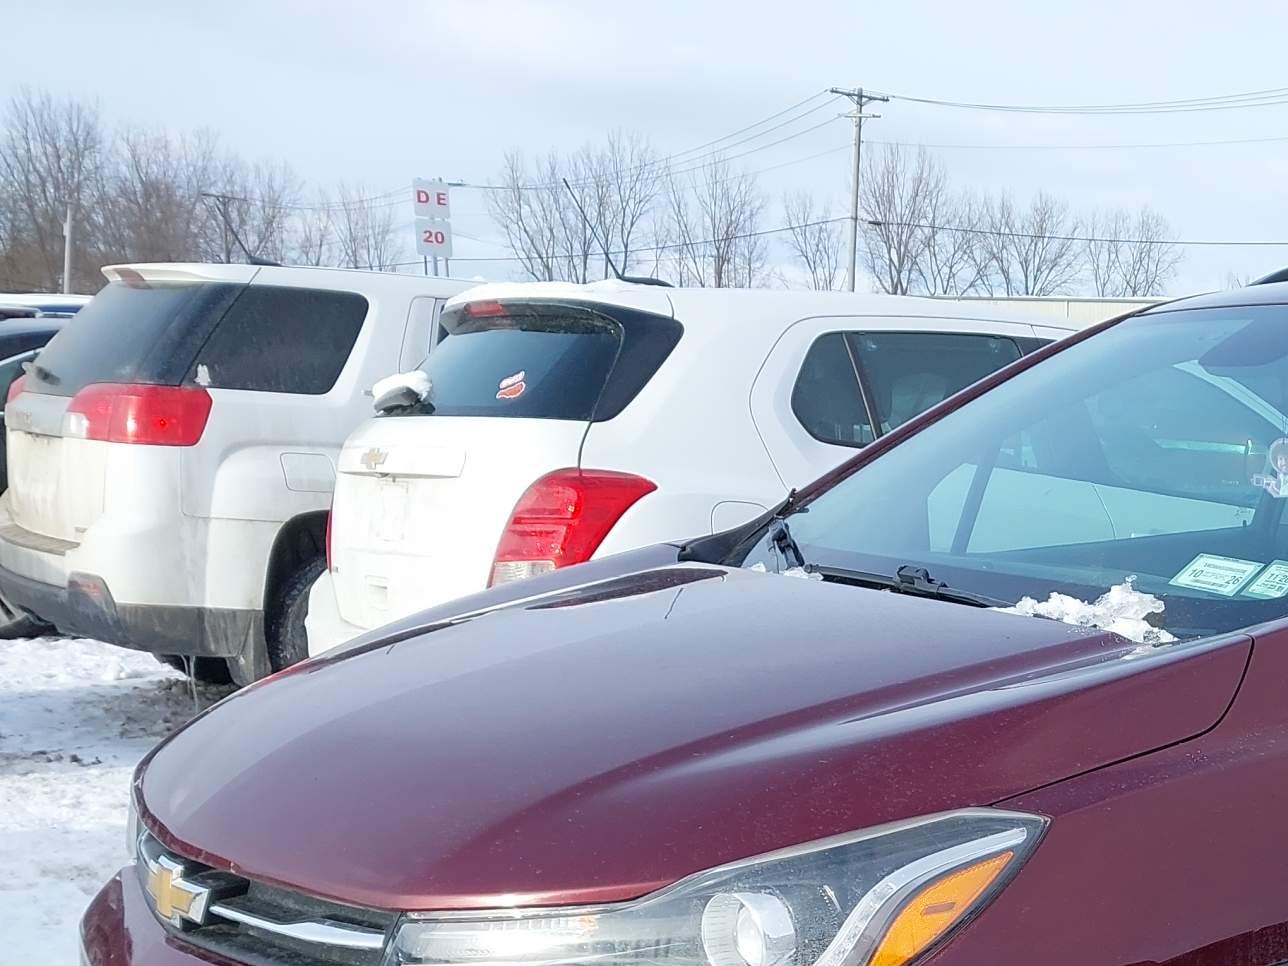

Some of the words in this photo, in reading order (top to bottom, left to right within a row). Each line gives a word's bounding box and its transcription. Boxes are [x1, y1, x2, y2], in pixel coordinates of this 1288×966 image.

[423, 229, 446, 245] 20
[1188, 567, 1205, 579] 10
[1224, 575, 1243, 586] 26
